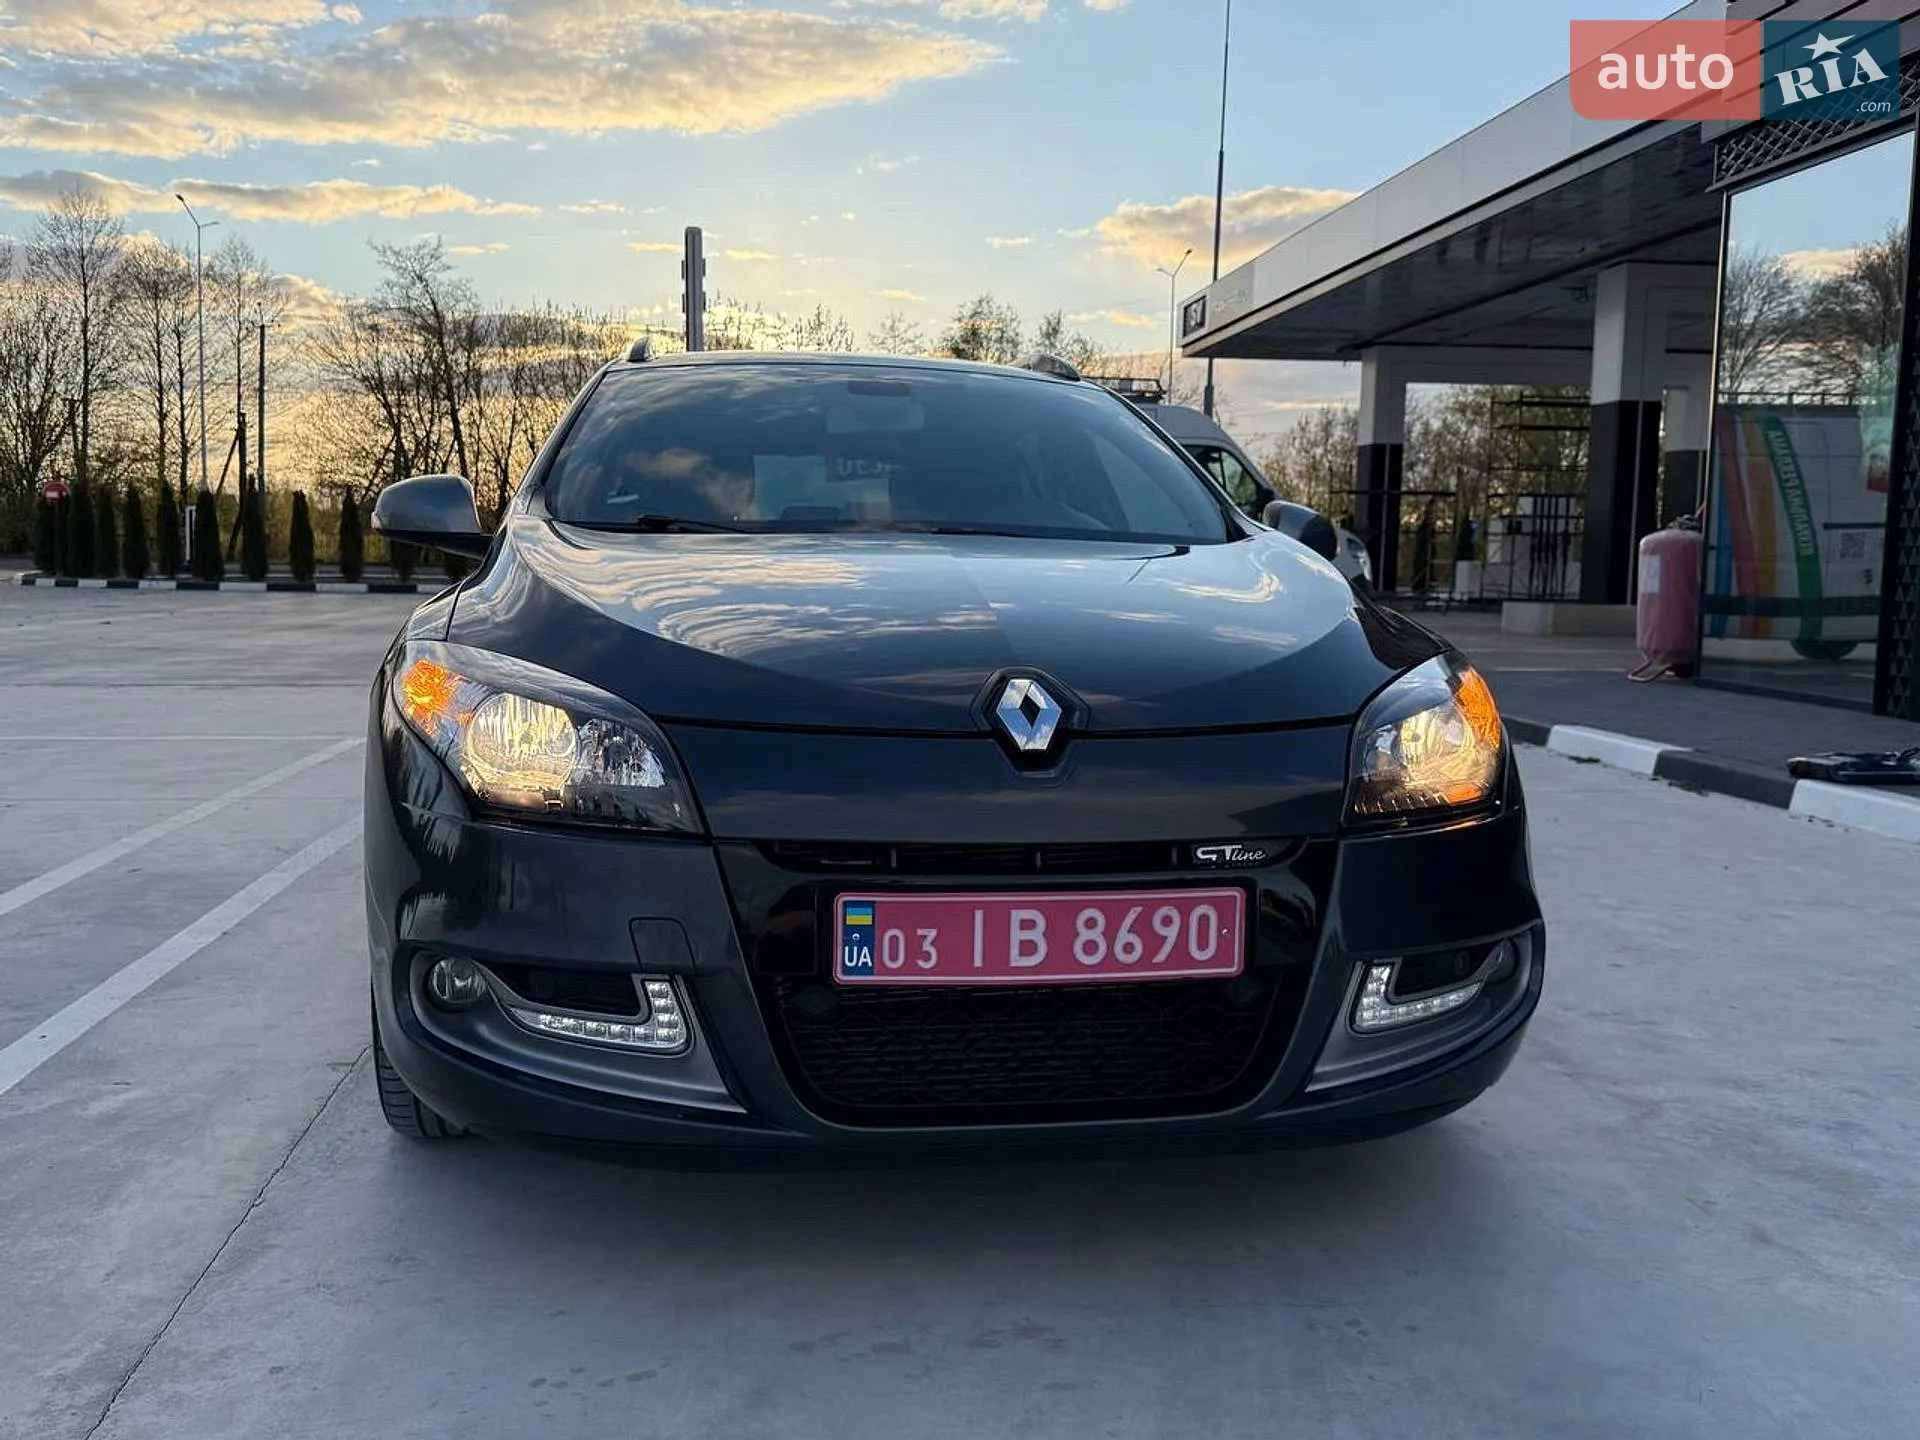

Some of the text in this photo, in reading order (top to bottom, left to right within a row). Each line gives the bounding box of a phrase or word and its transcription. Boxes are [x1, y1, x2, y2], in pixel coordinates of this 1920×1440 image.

[844, 946, 872, 968] UA
[882, 904, 1218, 969] 03 IB 8690
